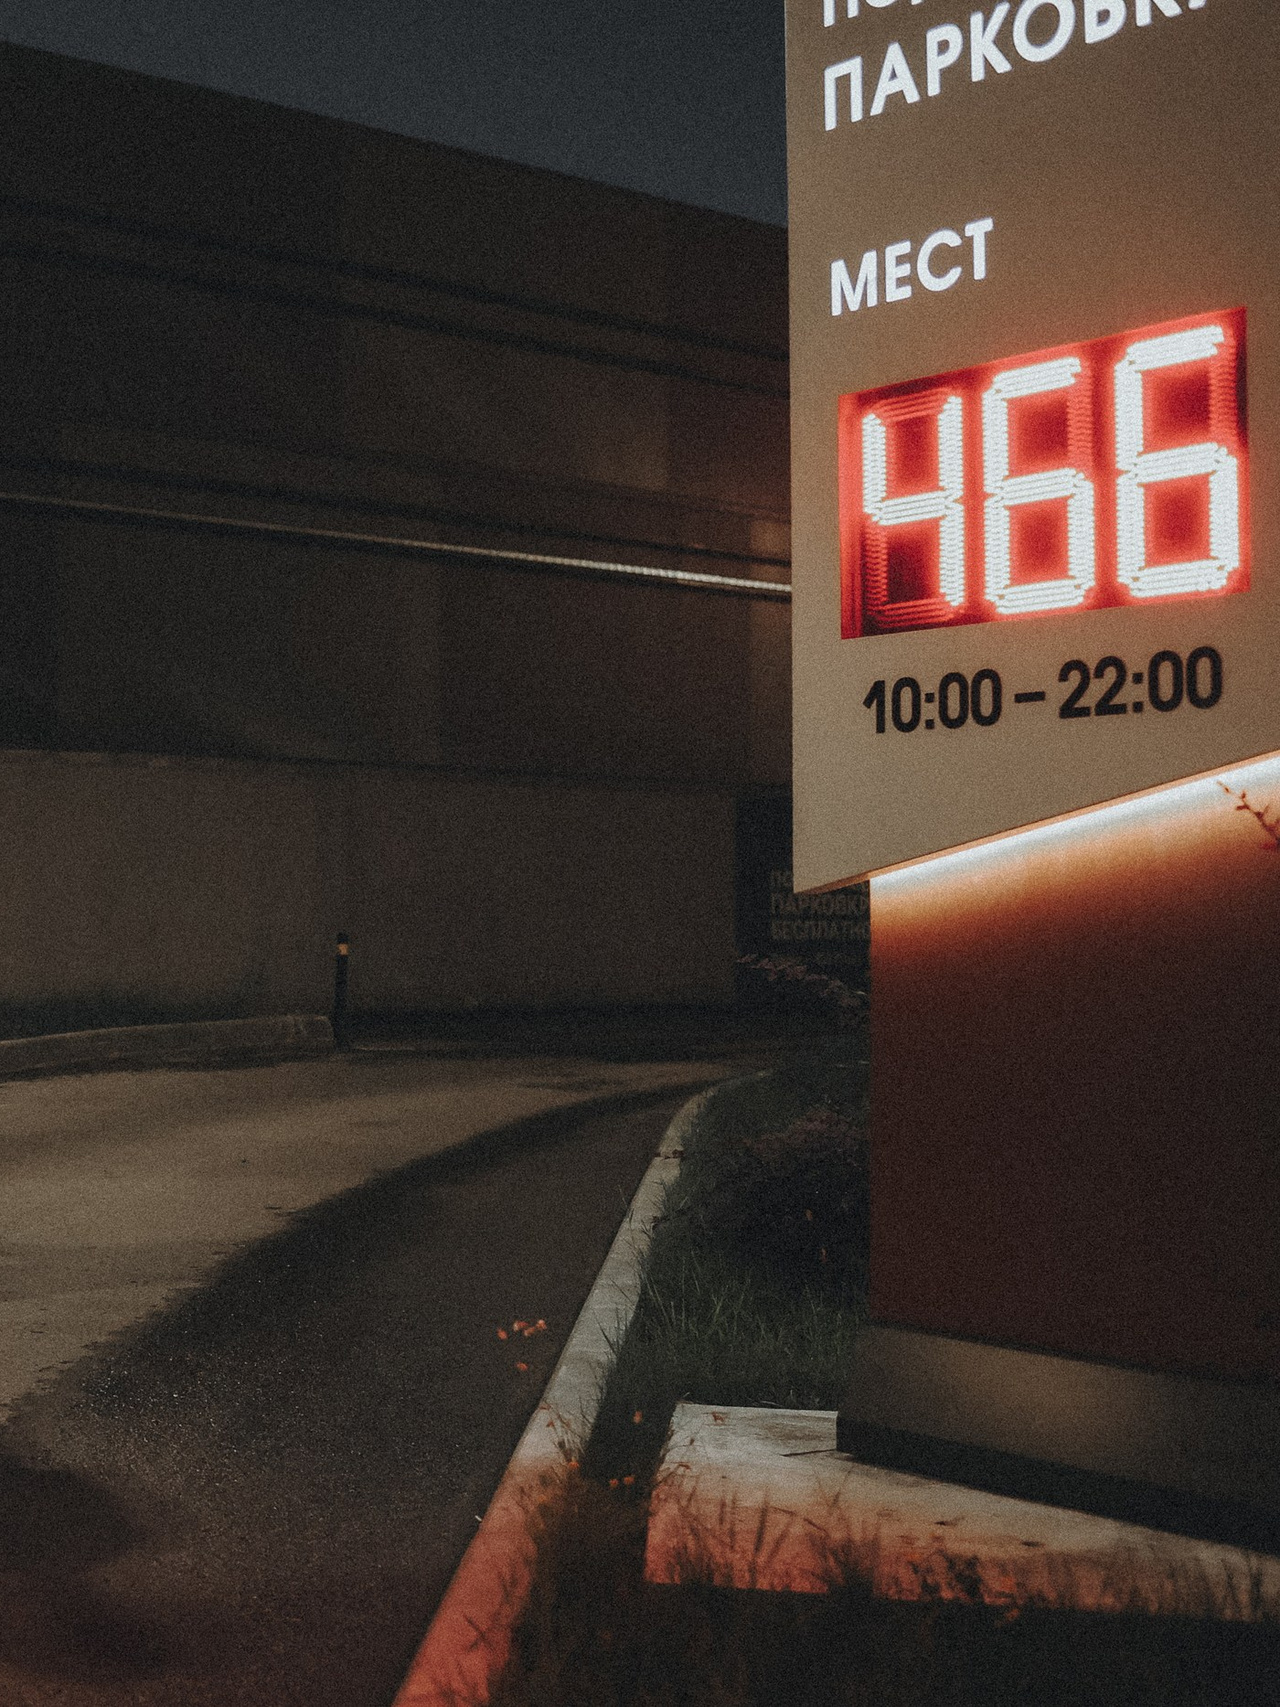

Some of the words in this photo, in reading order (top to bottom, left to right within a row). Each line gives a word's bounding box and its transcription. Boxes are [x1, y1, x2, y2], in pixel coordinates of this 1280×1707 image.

[824, 0, 1208, 131] ПАРКОВ
[830, 217, 994, 316] МЕСТ
[862, 325, 1239, 614] 466
[863, 668, 1002, 734] 10:00
[1058, 647, 1223, 719] 22:00
